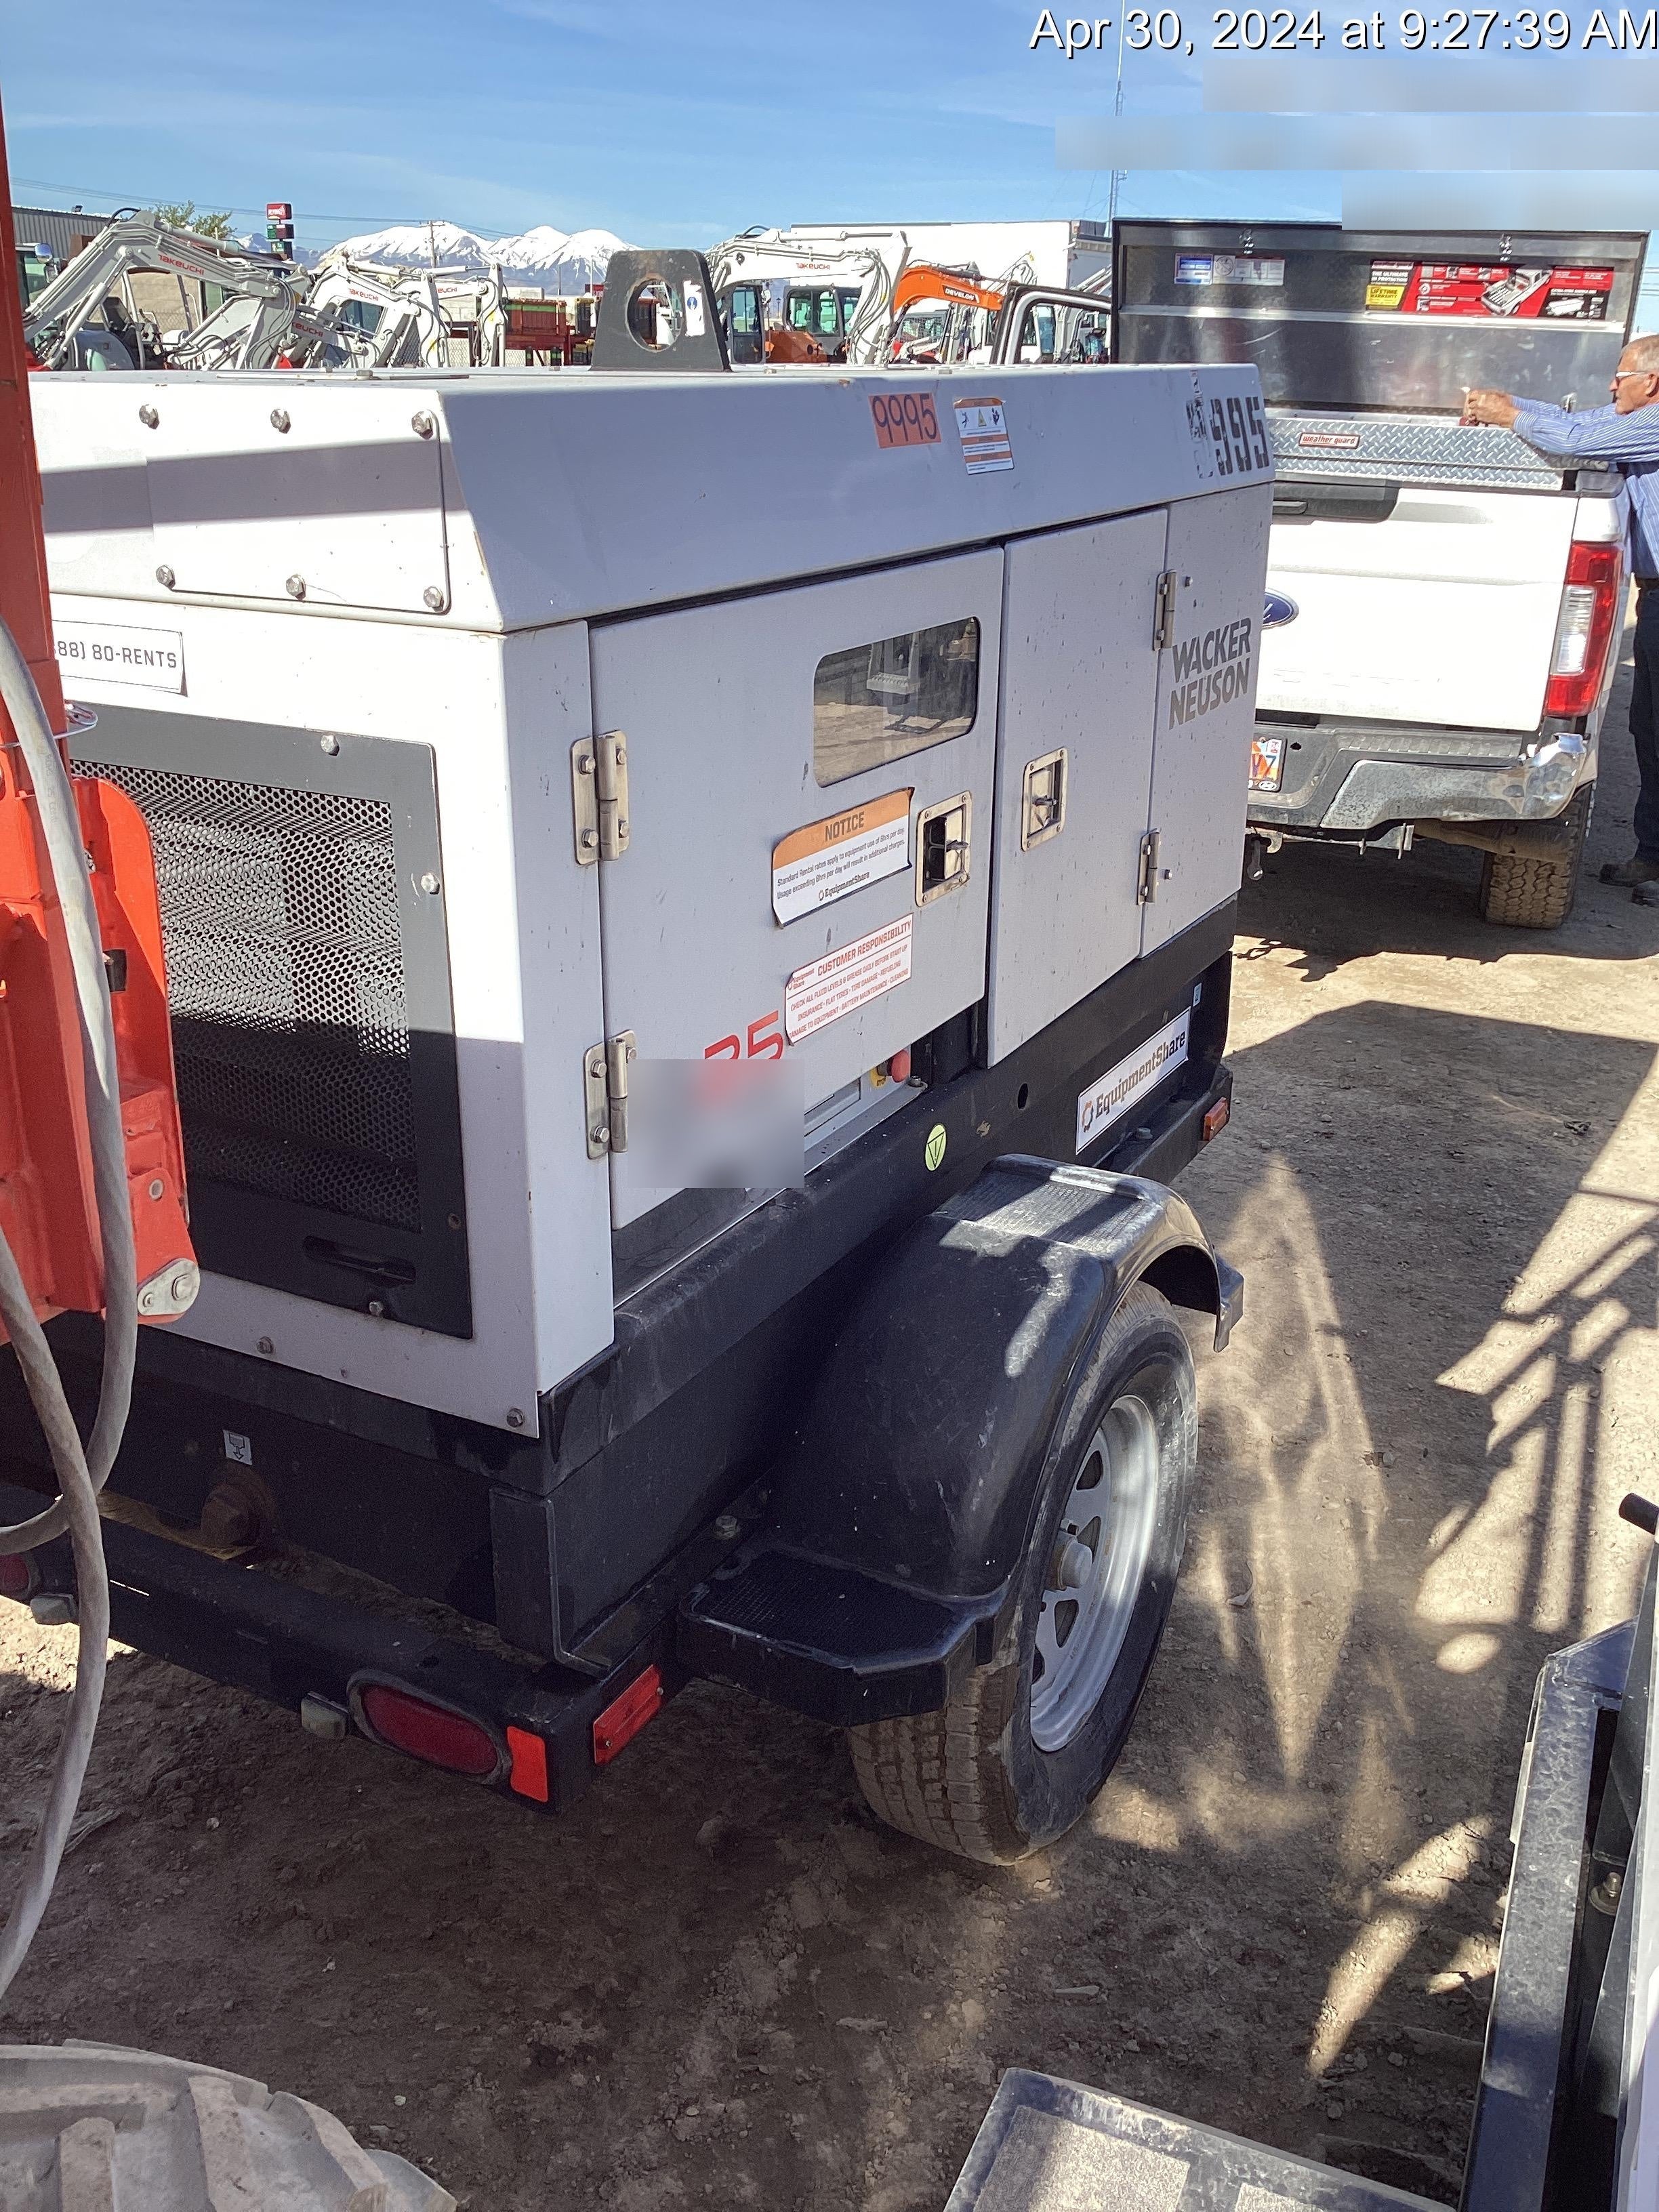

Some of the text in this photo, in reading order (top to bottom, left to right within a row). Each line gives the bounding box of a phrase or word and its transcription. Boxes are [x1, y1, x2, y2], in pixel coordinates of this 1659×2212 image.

[872, 393, 937, 443] 9995
[1303, 434, 1356, 445] weather guard
[54, 640, 177, 668] 88) 80-RENTS
[1172, 617, 1251, 683] WACKER
[1169, 657, 1250, 731] NEUSON
[825, 811, 865, 842] NOTICE
[817, 921, 912, 977] CUSTOMER RESPONSIBILITY
[1096, 1030, 1186, 1120] EquipmentShare
